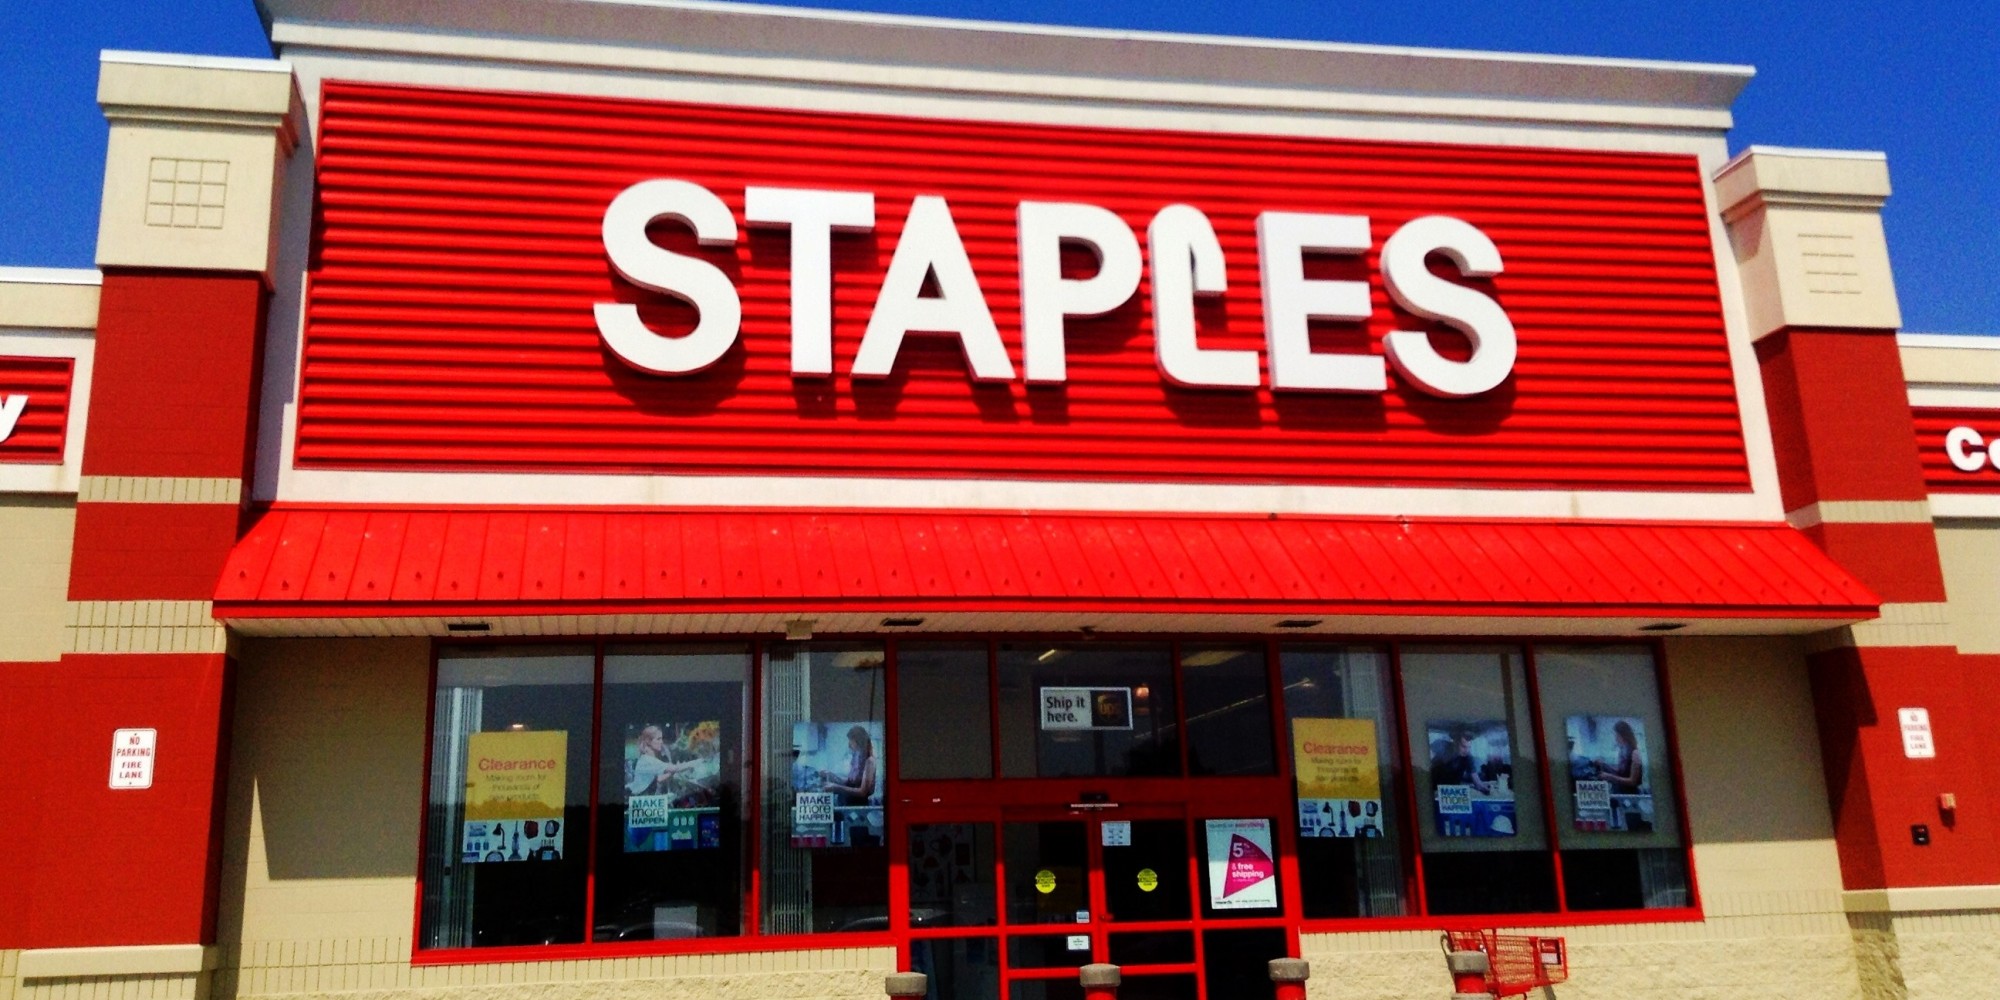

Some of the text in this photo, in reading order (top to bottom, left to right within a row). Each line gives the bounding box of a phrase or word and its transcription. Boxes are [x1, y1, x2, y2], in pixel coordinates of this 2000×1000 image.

[593, 178, 1518, 397] STAPLES
[1046, 696, 1085, 711] Ship it
[1047, 711, 1078, 722] here.
[129, 736, 140, 745] NO
[116, 748, 151, 757] PARKING
[1303, 741, 1369, 755] Clearance
[122, 761, 142, 769] FIRE
[478, 758, 556, 771] Clearance
[119, 771, 143, 779] LANE
[1441, 788, 1467, 796] MAKE
[1578, 783, 1605, 792] MAKE
[632, 799, 665, 808] MAKE
[800, 796, 831, 804] MAKE
[632, 808, 665, 817] more
[800, 805, 831, 814] more
[632, 817, 665, 825] HAPPEN
[1238, 862, 1254, 870] free
[1232, 870, 1265, 879] shipping
